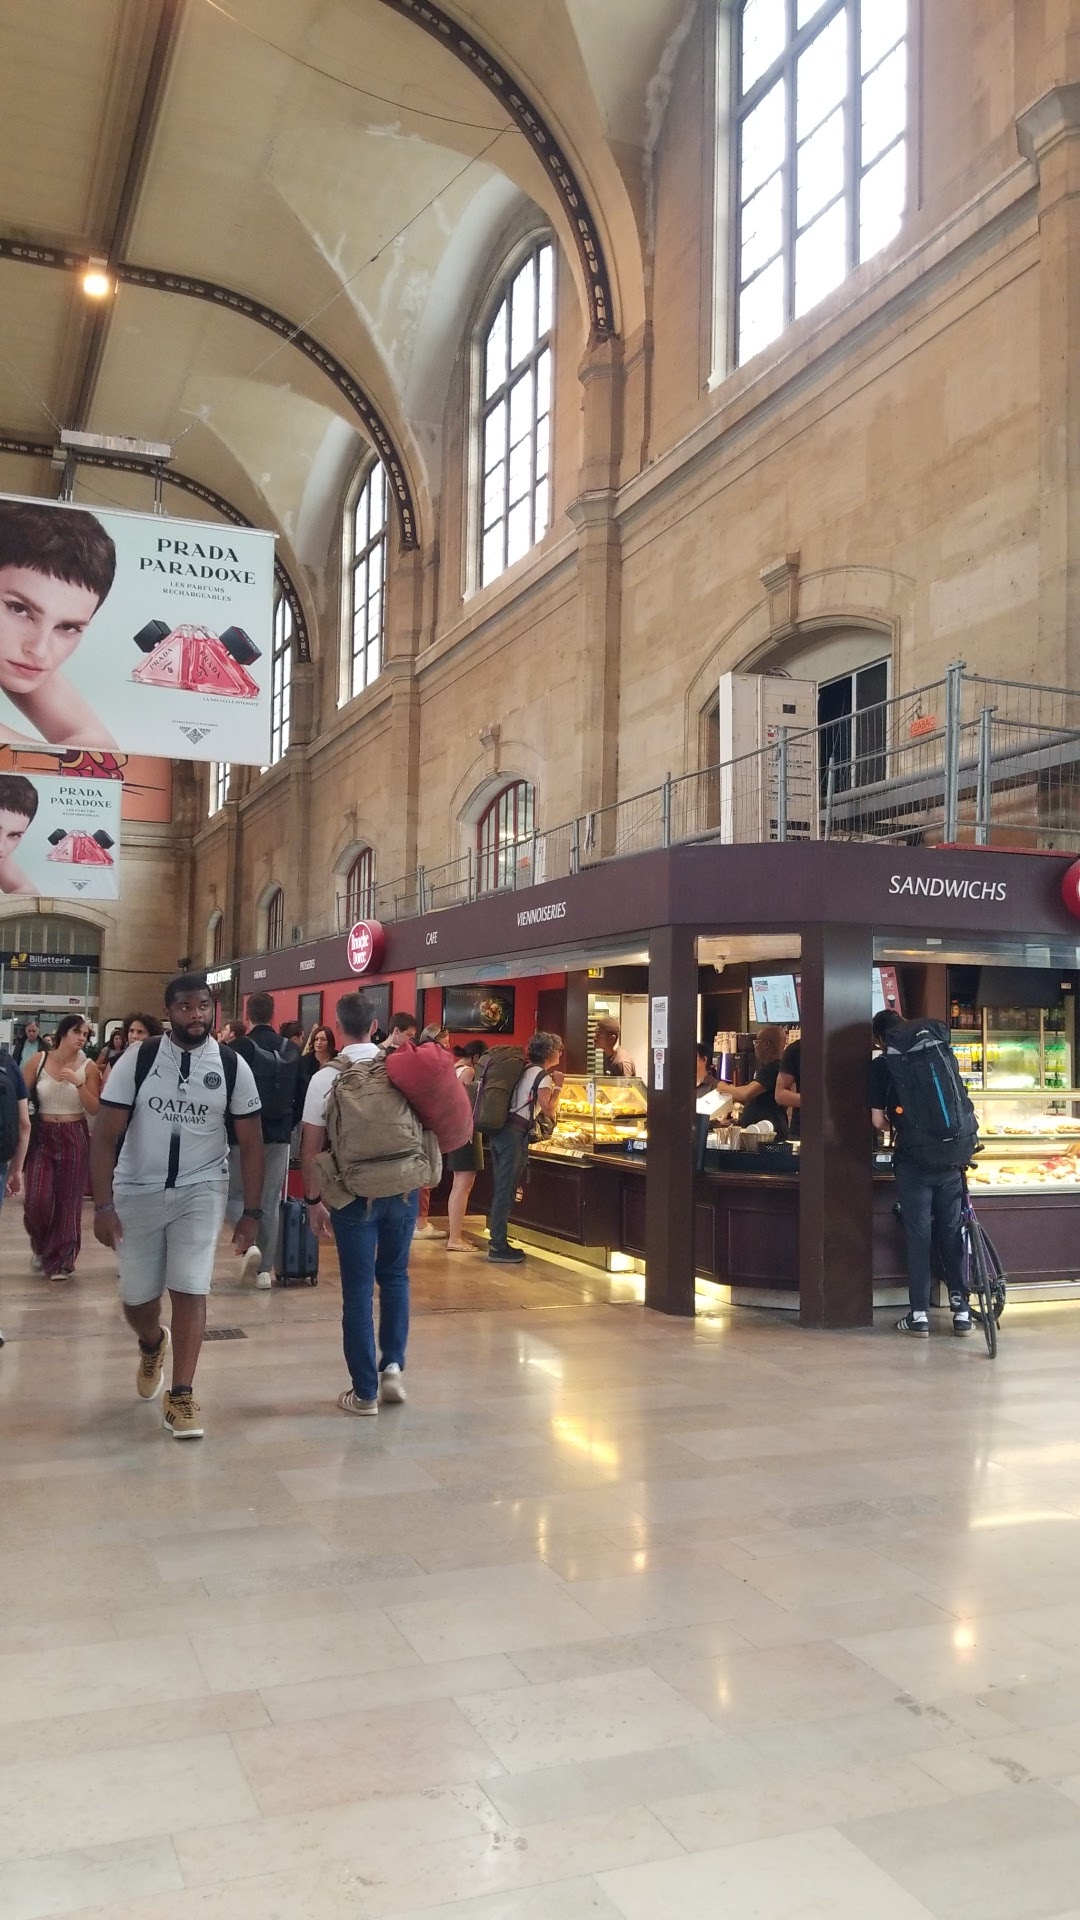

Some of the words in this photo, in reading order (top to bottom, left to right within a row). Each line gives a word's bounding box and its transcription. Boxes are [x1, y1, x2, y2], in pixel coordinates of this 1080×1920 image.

[157, 538, 239, 563] PRADA
[139, 557, 256, 585] PARADOXE
[163, 588, 232, 602] RECHARGEABLES
[187, 583, 225, 593] PARFUMS
[149, 647, 173, 670] PRADA
[199, 650, 221, 679] PRADA
[59, 787, 103, 797] PRADA
[50, 797, 112, 808] PARADOXE
[888, 875, 1007, 901] SANDWICHS
[517, 902, 567, 927] VIENNOISERIES
[425, 931, 438, 946] CAFE
[29, 955, 71, 964] Billetterie
[148, 1096, 209, 1116] QATAR
[161, 1113, 206, 1125] AIRWAYS
